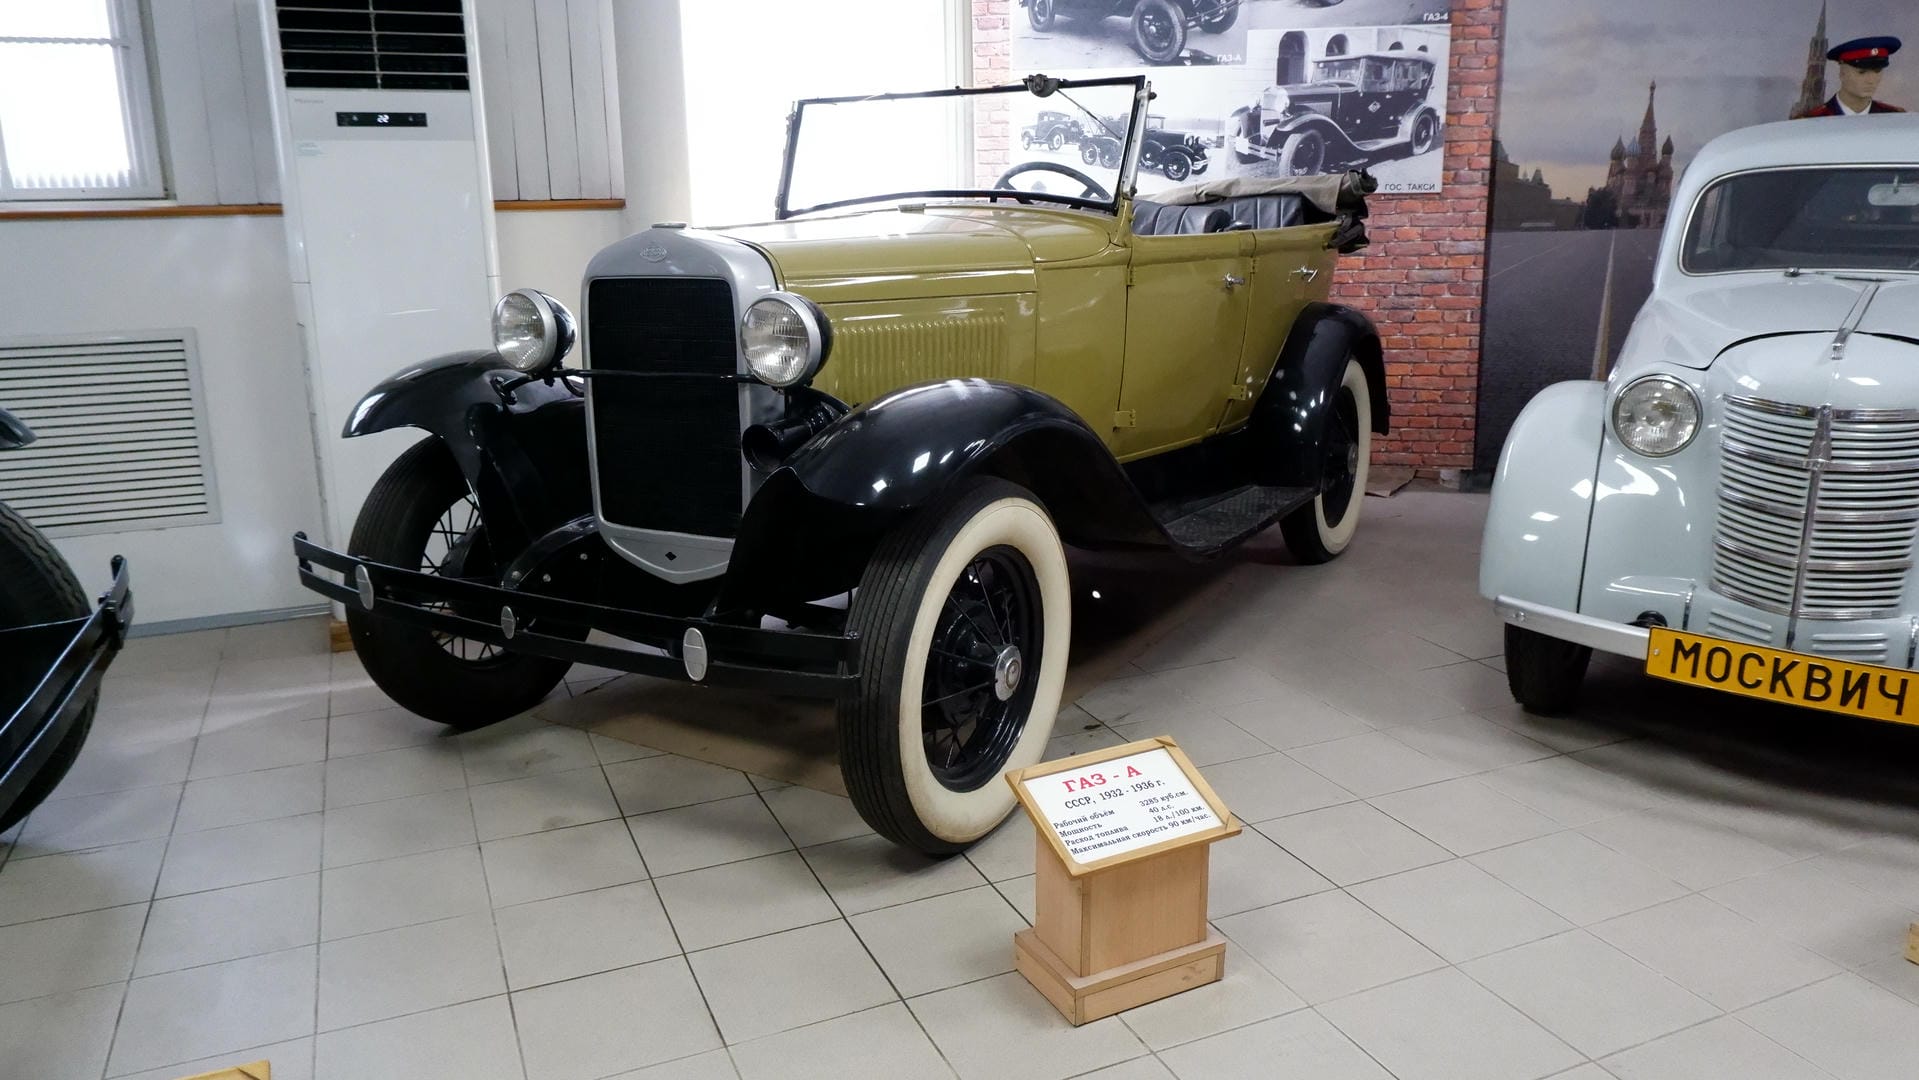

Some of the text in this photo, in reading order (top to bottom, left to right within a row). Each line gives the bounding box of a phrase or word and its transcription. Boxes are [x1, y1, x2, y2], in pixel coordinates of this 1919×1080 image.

[1216, 54, 1242, 63] ГАЗ-А
[1384, 183, 1436, 191] ГОС ТАКСИ
[1670, 638, 1909, 716] МОСКВИЧ
[1062, 773, 1107, 793] ГАЗ
[1126, 765, 1143, 778] А
[1064, 796, 1096, 809] СССР,
[1099, 788, 1125, 801] 1932
[1130, 780, 1155, 793] 1936
[1053, 815, 1089, 829] Рабочий
[1139, 797, 1160, 807] 3285
[1058, 823, 1103, 838] Мощность
[1065, 835, 1095, 846] Расход
[1095, 825, 1129, 839] топлива
[1070, 834, 1131, 855] Максимальная
[1132, 825, 1169, 839] скорость
[1168, 820, 1180, 828] 90
